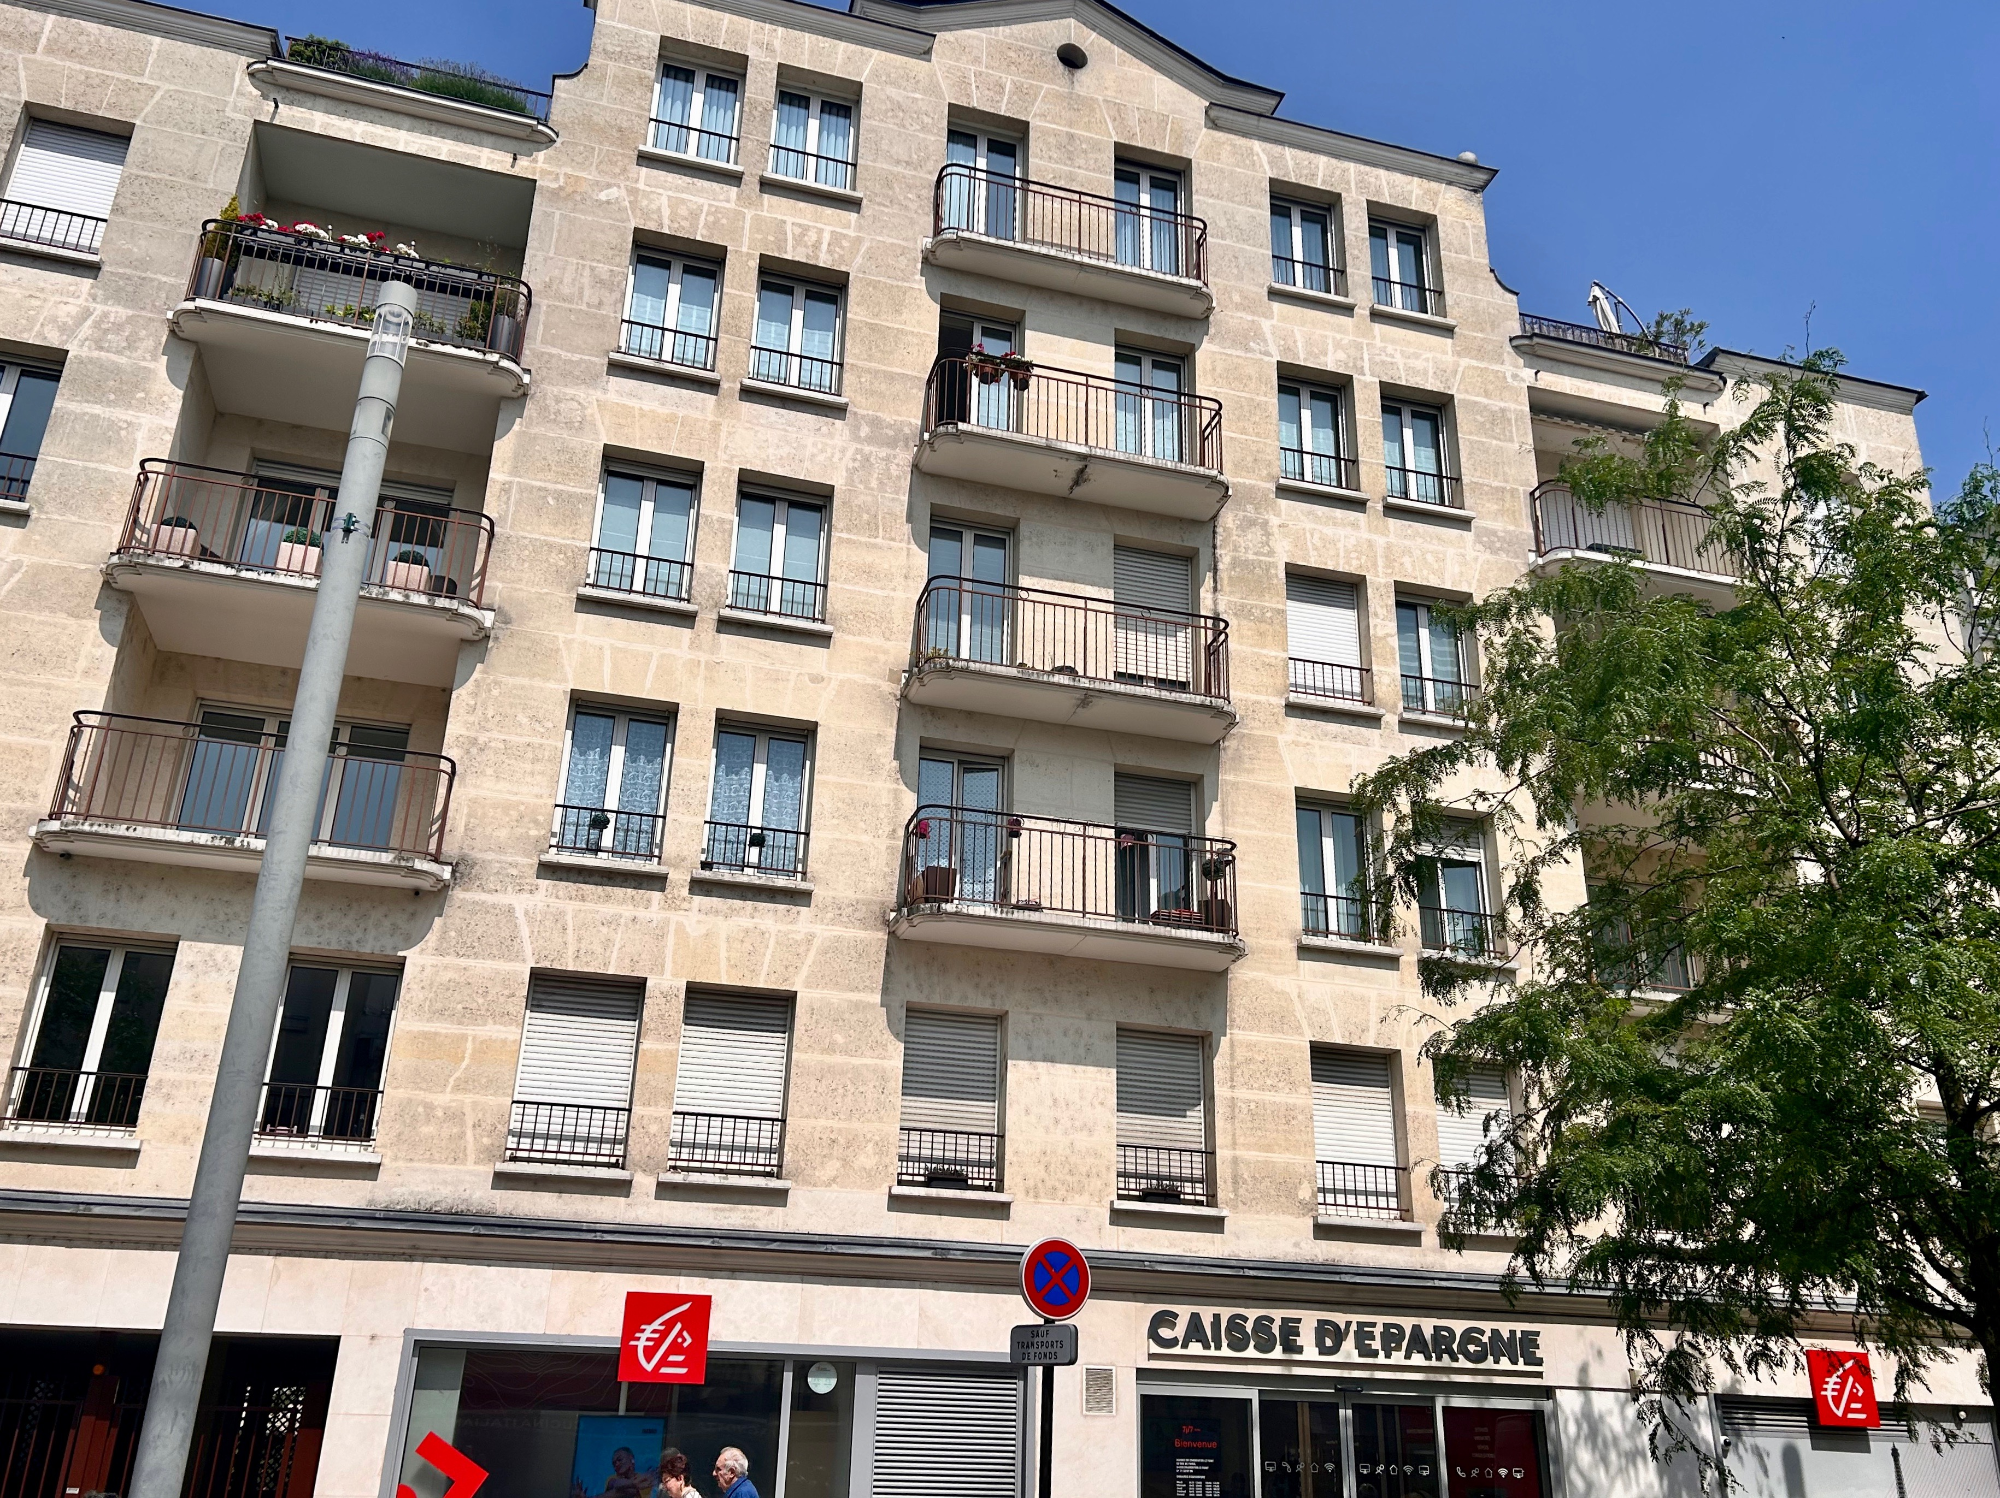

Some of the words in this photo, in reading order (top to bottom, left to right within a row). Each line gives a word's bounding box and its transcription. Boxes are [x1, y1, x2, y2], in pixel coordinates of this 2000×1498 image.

[1031, 1329, 1050, 1339] SAUF
[1148, 1309, 1304, 1355] CAISSE
[1314, 1318, 1544, 1366] D'EPARGNE
[1017, 1340, 1064, 1350] TRANSPORTS
[1022, 1352, 1031, 1361] DE
[1034, 1351, 1058, 1361] FONDS
[1174, 1438, 1218, 1449] Bienvenue
